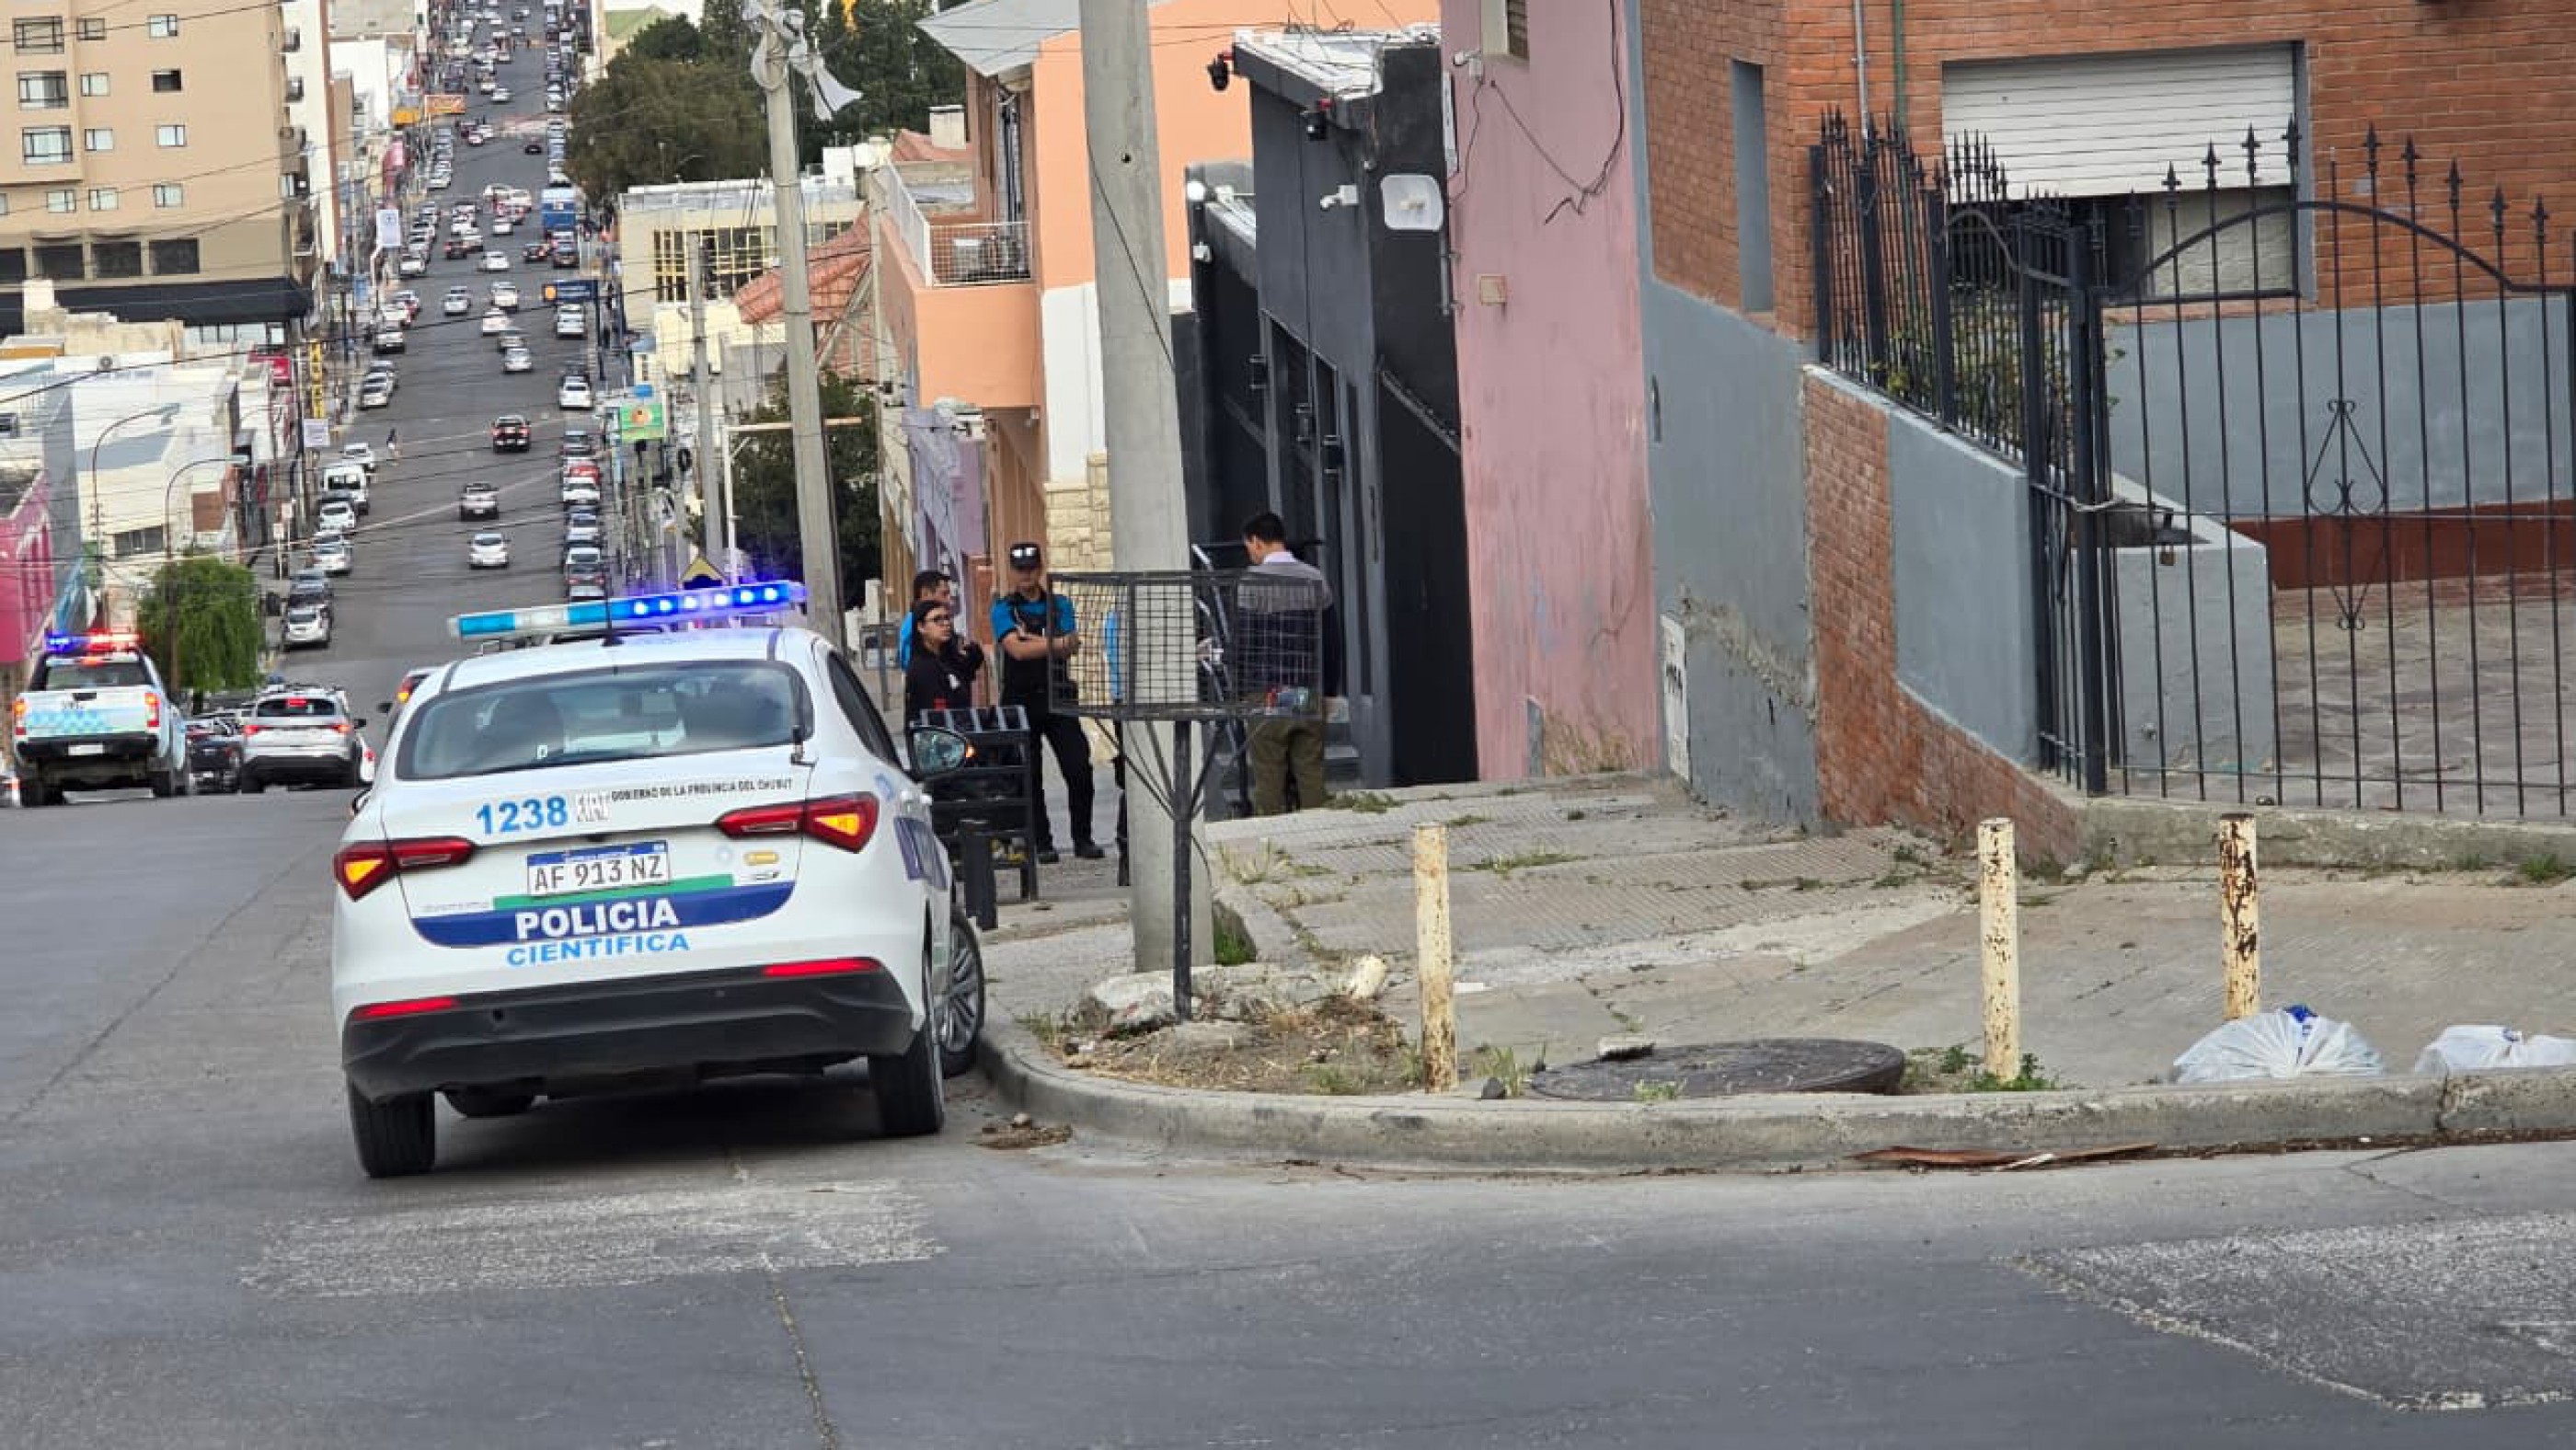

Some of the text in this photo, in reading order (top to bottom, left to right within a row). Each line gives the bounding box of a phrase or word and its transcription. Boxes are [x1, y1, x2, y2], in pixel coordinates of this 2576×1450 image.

[477, 795, 569, 834] 1238
[535, 865, 564, 891] AF
[575, 859, 623, 886] 913
[631, 855, 663, 880] NZ
[515, 897, 680, 939] POLICIA
[507, 933, 690, 967] CIENTIFICA
